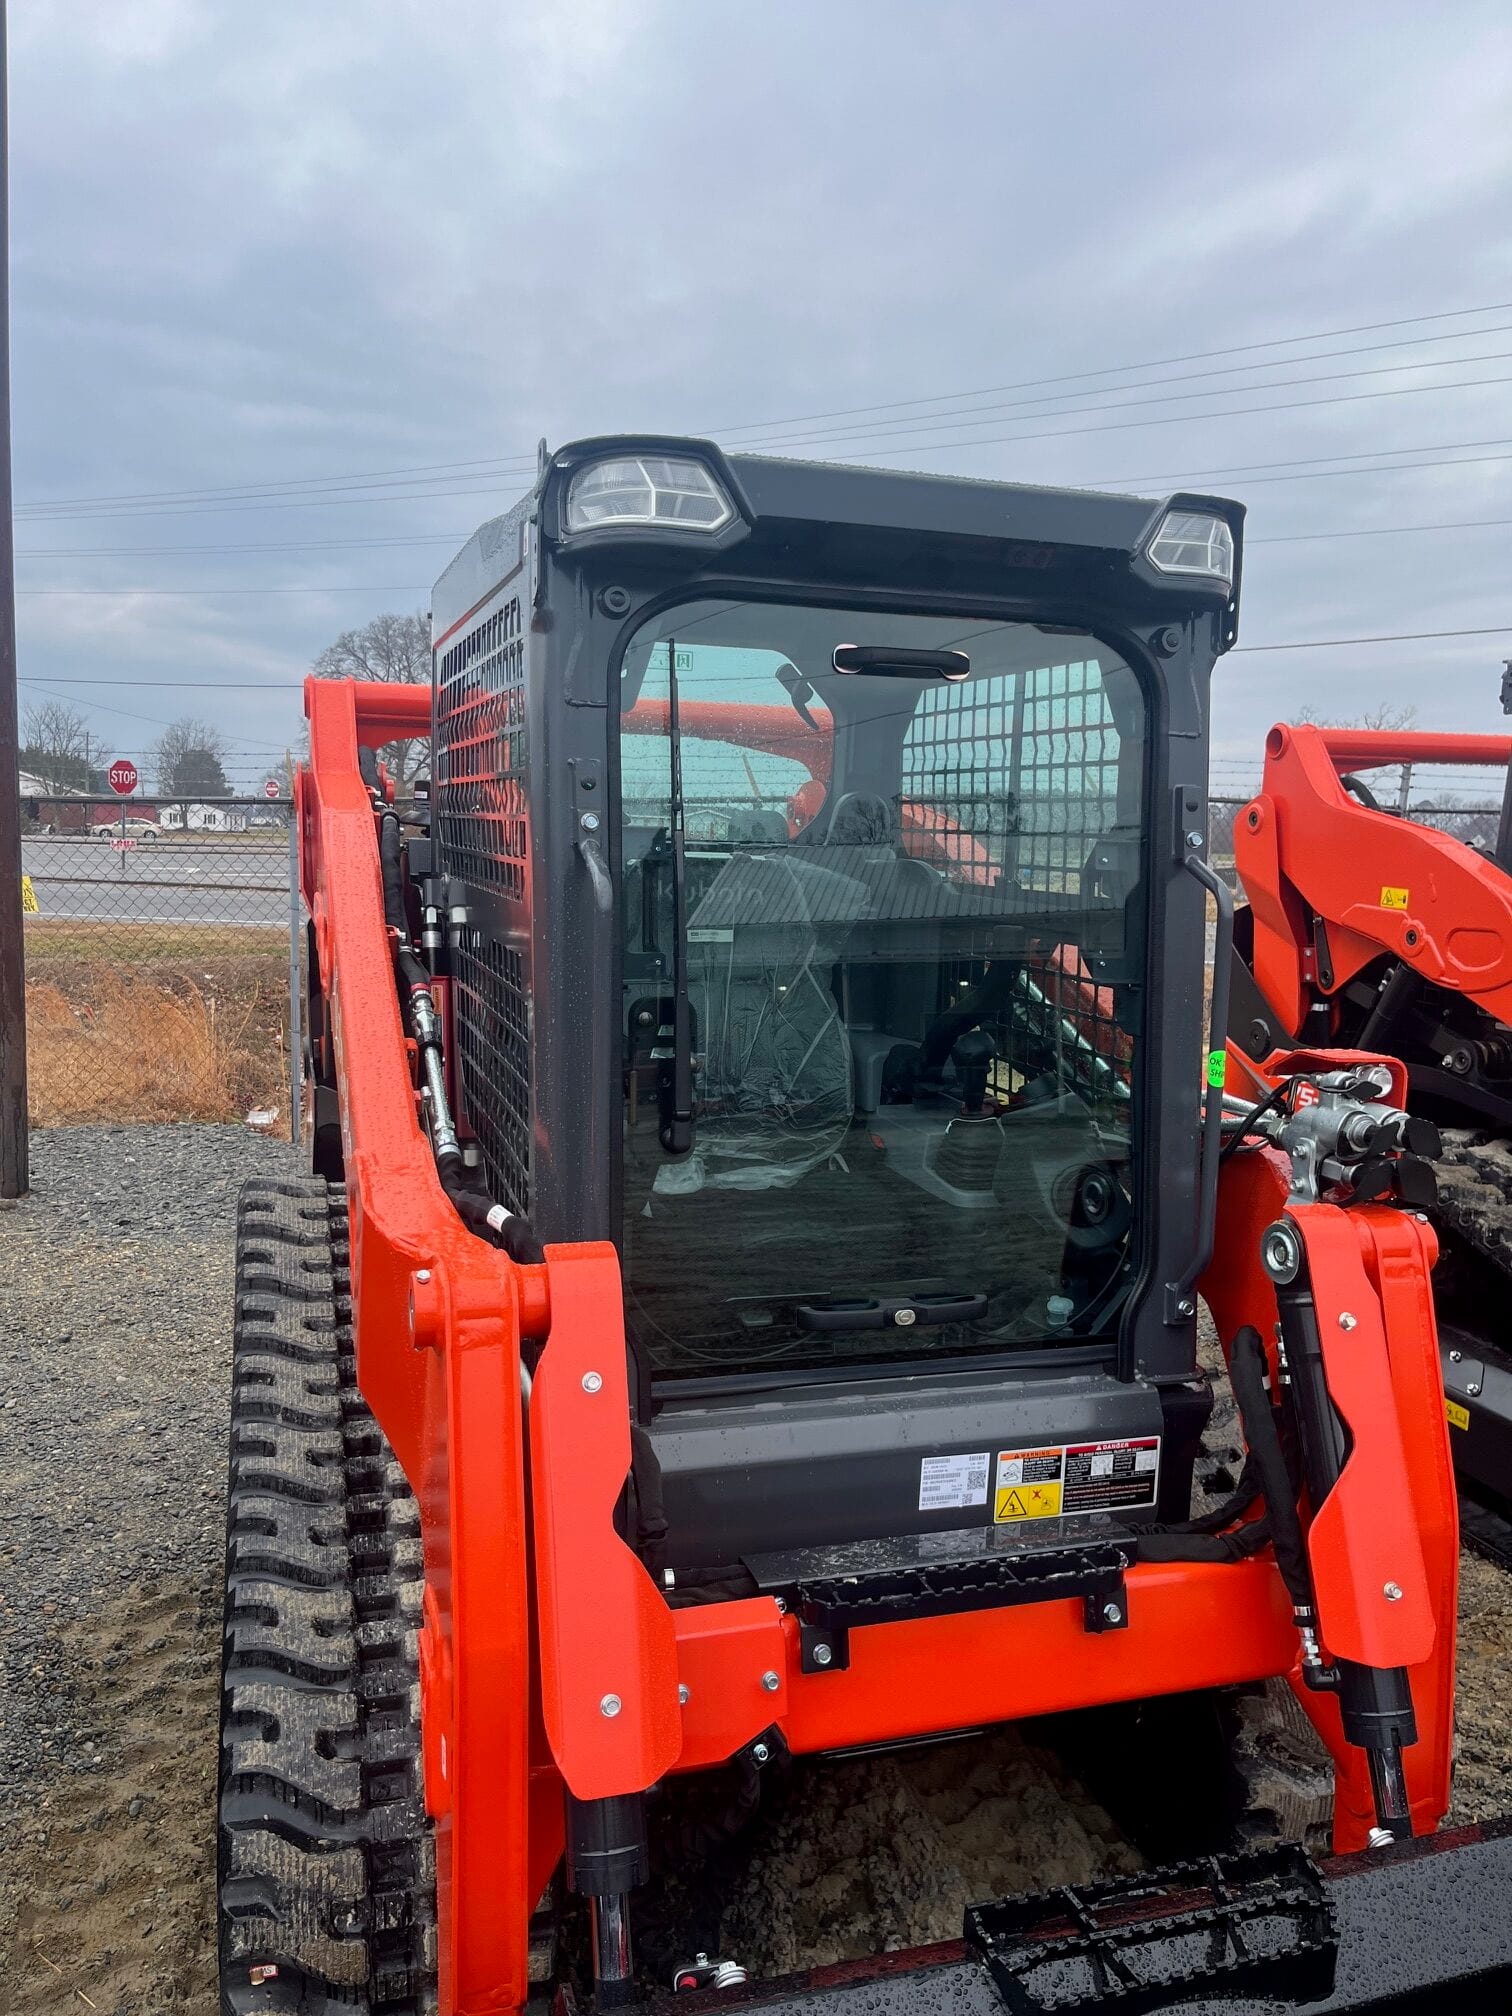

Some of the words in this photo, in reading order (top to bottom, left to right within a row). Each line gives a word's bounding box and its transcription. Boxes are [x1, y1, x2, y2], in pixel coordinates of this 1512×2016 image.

[111, 770, 136, 784] STOP
[1209, 1057, 1222, 1067] OK
[1102, 1442, 1129, 1450] DANGER
[1021, 1450, 1050, 1458] WARNING
